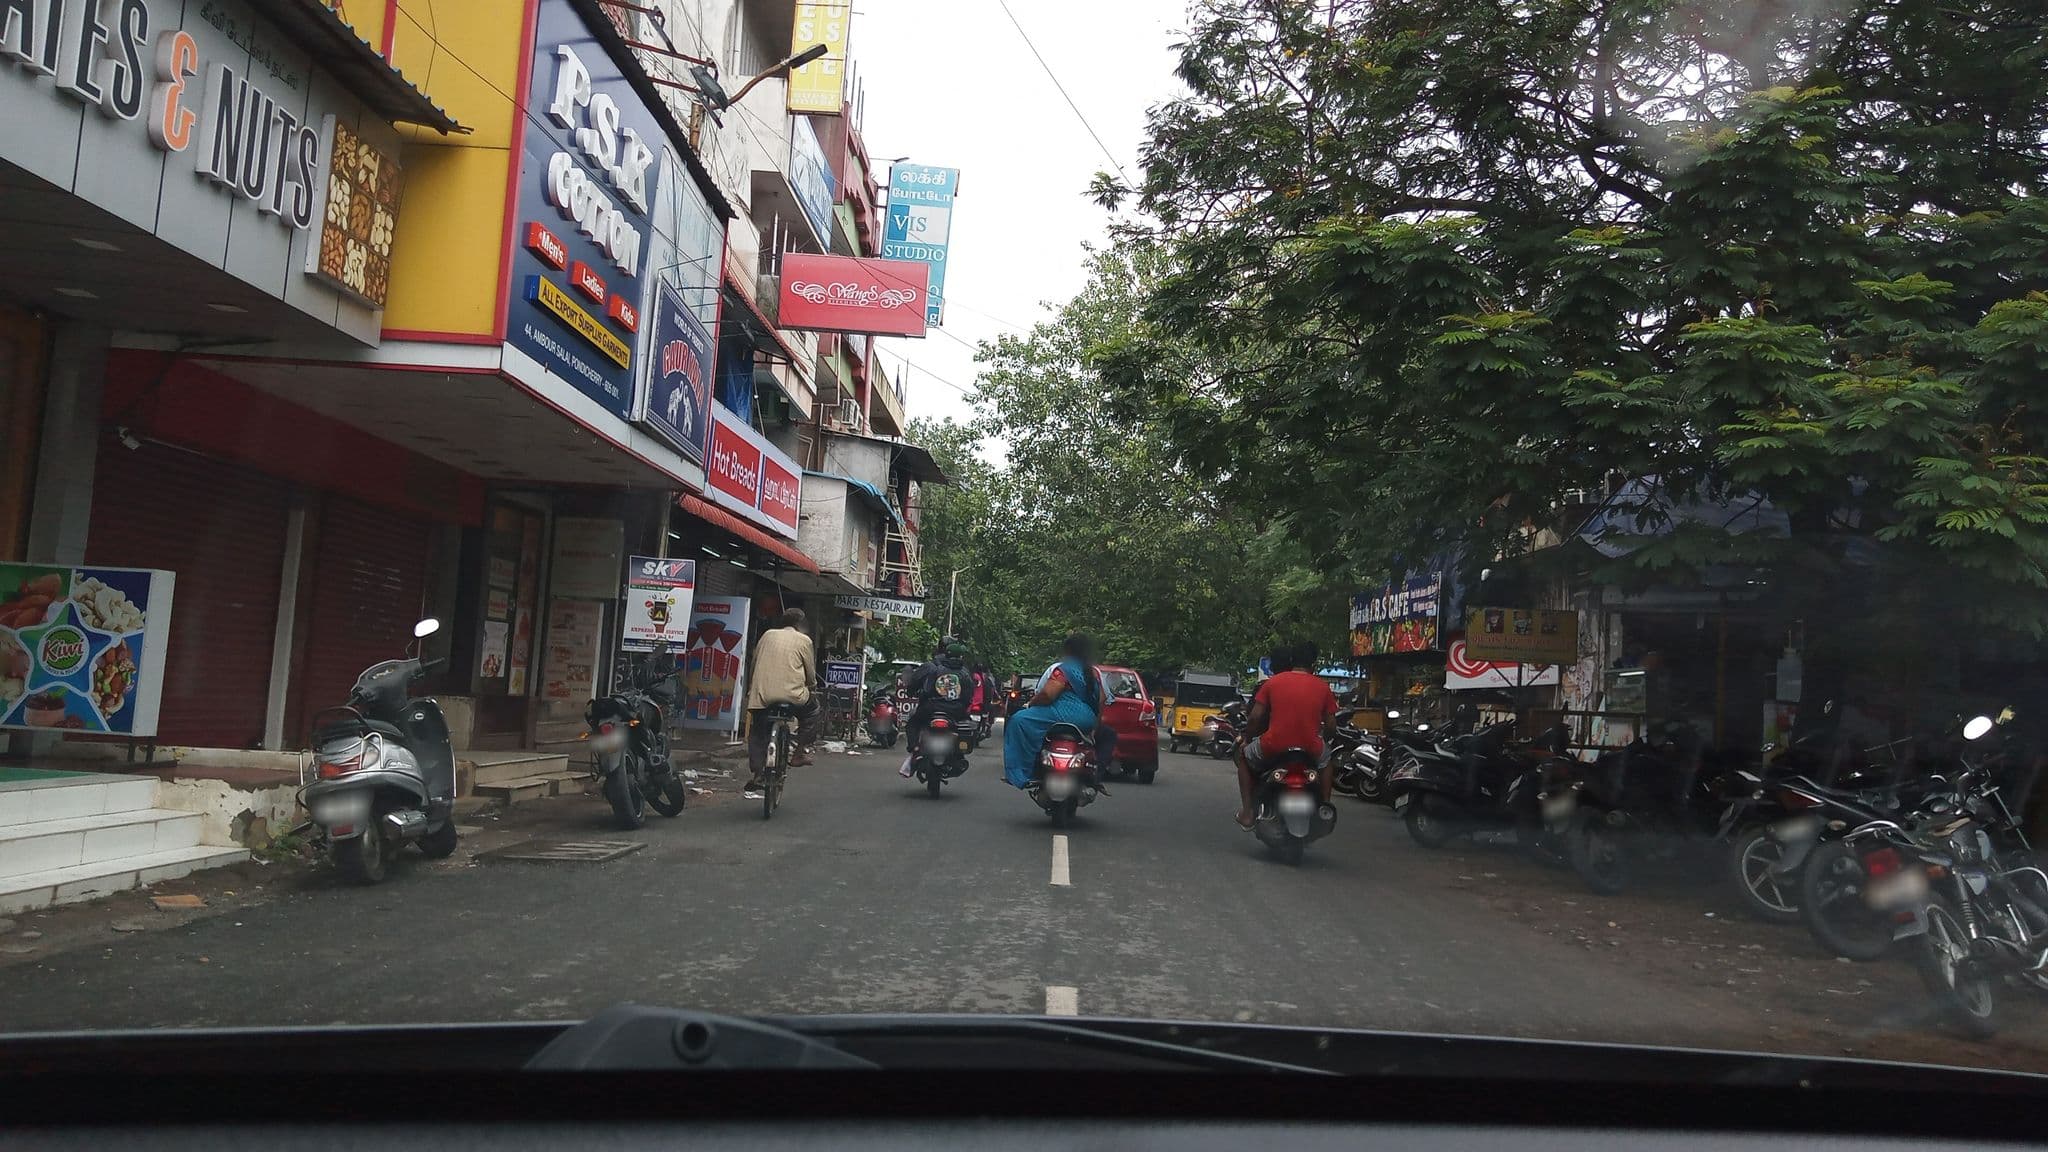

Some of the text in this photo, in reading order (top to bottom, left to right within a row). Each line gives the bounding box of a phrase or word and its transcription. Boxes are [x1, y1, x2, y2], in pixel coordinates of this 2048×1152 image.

[550, 44, 654, 216] PSK
[207, 63, 320, 230] NUTS
[900, 168, 946, 186] லக்கி
[892, 187, 951, 202] போட்டோ
[893, 214, 928, 233] VIS
[541, 230, 564, 264] Men's
[884, 244, 946, 262] STUDIO
[582, 267, 604, 300] Ladies
[543, 285, 629, 364] ALL EXPORT SURPLUS GARMENTS
[620, 303, 634, 326] Kids
[533, 330, 556, 354] AMBOUR
[571, 355, 602, 387] PONDICHERRY
[712, 439, 756, 492] Hot Breads
[836, 595, 922, 615] PARIS RESTAURANT
[42, 638, 84, 663] Kiwi
